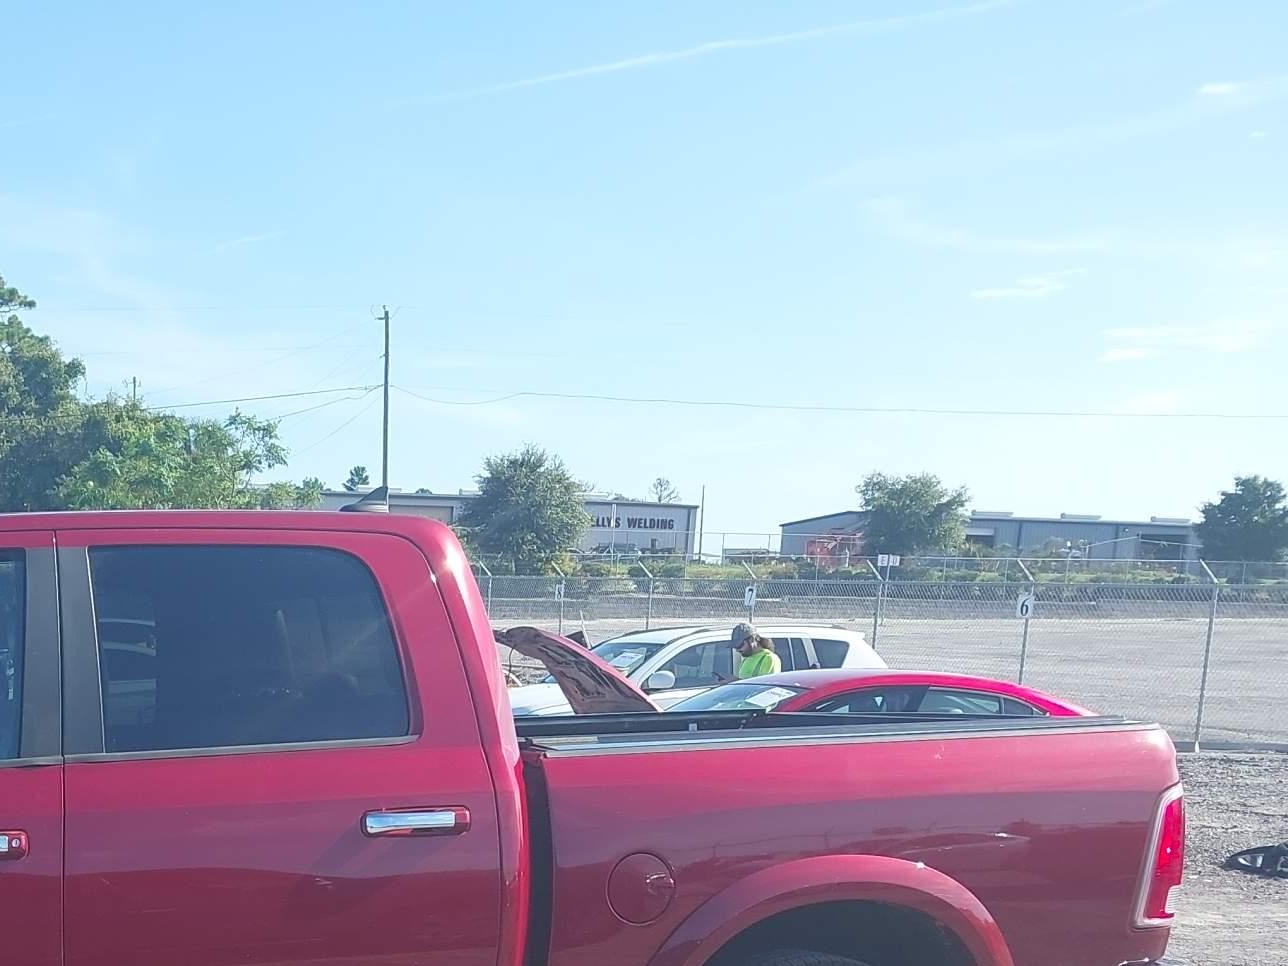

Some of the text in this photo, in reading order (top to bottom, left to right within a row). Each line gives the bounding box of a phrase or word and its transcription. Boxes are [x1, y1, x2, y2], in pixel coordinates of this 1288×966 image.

[627, 517, 675, 529] WELDING
[556, 586, 562, 600] 8
[748, 587, 754, 604] 7
[1020, 597, 1031, 617] 6
